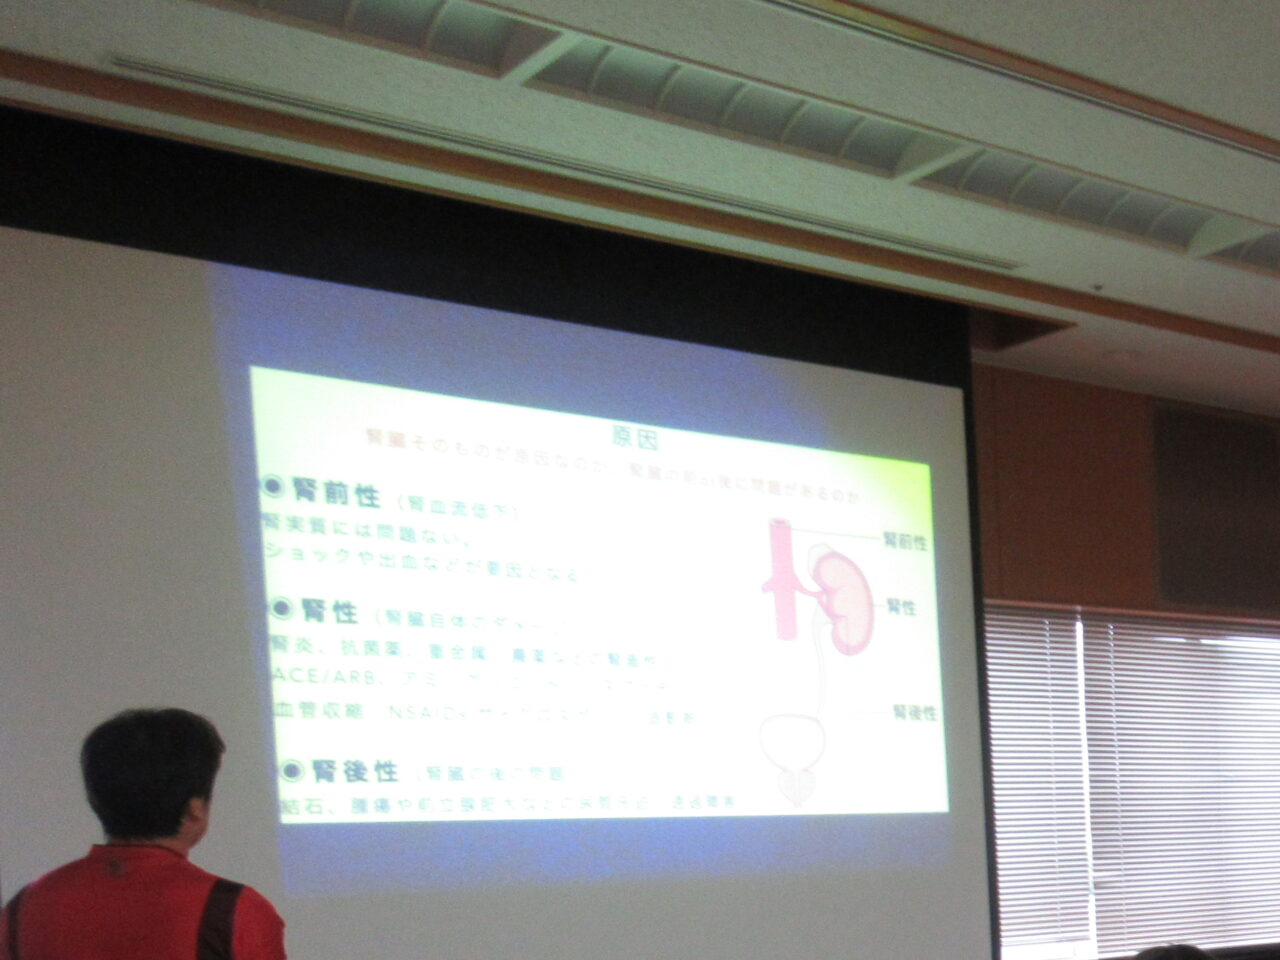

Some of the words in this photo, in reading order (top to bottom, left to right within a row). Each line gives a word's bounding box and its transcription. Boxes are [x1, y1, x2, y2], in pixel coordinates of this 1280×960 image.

[612, 425, 658, 450] 原因
[292, 476, 381, 508] 腎前性
[883, 531, 928, 551] 腎前性
[301, 597, 359, 624] 腎性
[886, 598, 917, 617] 腎性
[893, 704, 938, 722] 腎後性
[312, 759, 399, 783] 腎後性
